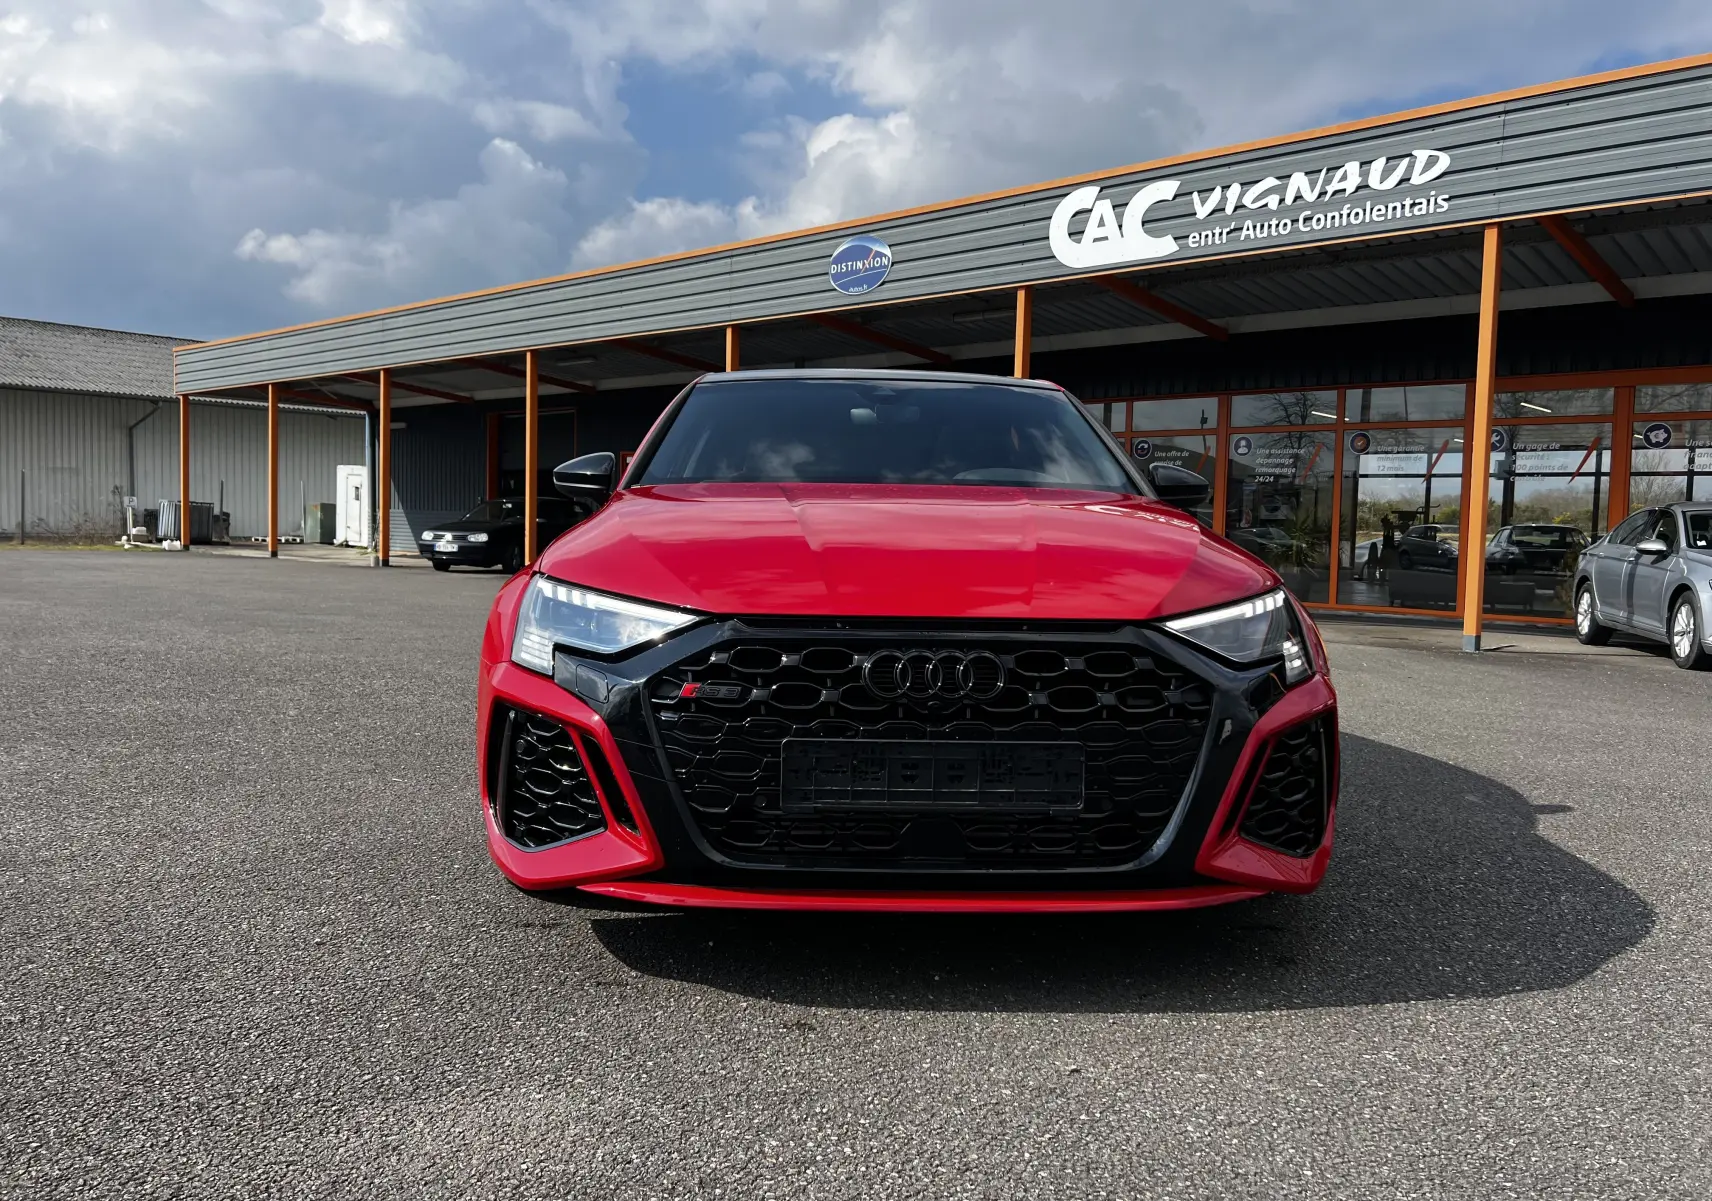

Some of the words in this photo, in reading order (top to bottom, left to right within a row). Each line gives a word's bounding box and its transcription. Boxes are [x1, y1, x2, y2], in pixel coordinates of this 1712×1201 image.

[1049, 180, 1181, 268] CAC
[1192, 149, 1451, 220] VIGNAUD
[1240, 217, 1292, 241] Auto
[1298, 190, 1450, 232] Confolentais
[831, 256, 888, 274] DISTINXION
[1512, 442, 1525, 450] Un
[1525, 443, 1548, 452] gage
[1549, 441, 1560, 450] de
[1684, 438, 1704, 447] Une
[1256, 447, 1270, 455] Une
[1376, 444, 1393, 452] Une
[1393, 444, 1425, 453] garantie
[1376, 454, 1412, 462] minimum
[1413, 454, 1423, 462] de
[1254, 466, 1297, 475] remorquage
[1386, 464, 1405, 472] mois
[1511, 463, 1527, 471] 100
[1527, 463, 1556, 472] points
[1556, 463, 1569, 471] de
[1254, 475, 1275, 483] 24/24
